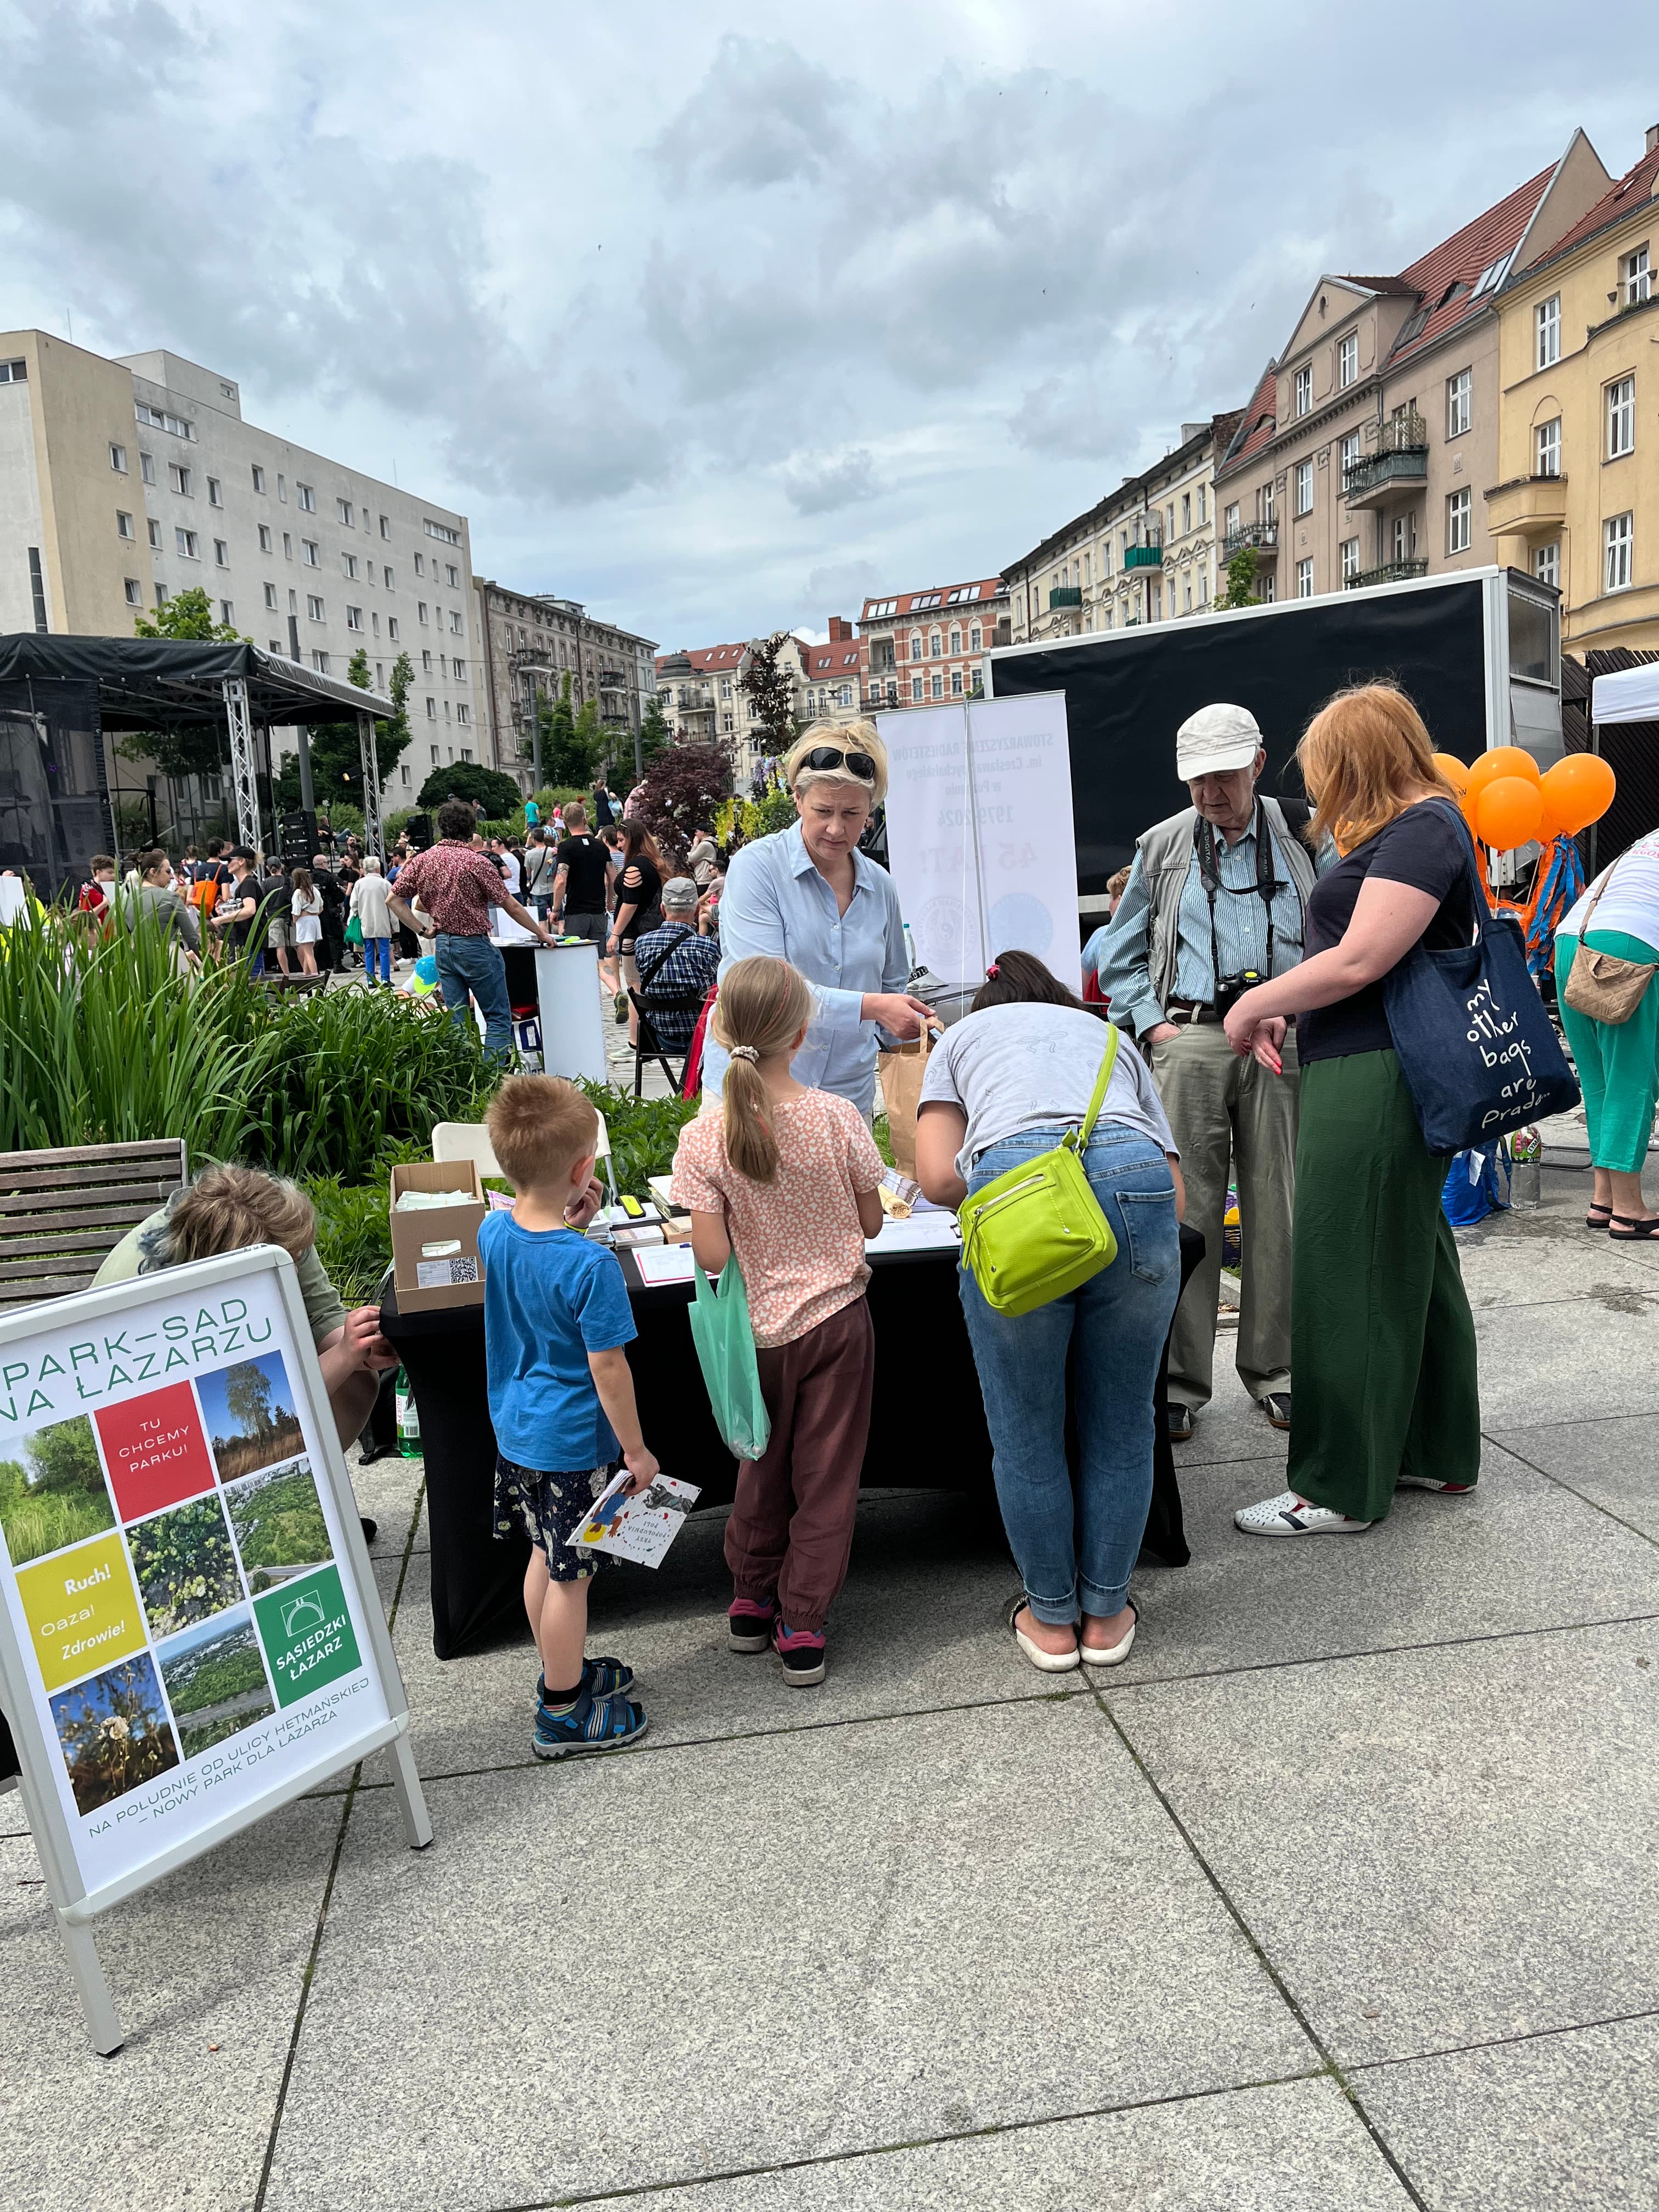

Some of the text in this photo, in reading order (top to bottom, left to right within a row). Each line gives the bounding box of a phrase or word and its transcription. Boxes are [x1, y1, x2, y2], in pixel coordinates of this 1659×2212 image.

[1467, 978, 1500, 1011] my
[1466, 1009, 1519, 1042] other
[1479, 1040, 1531, 1076] bags
[1501, 1077, 1537, 1098] are
[77, 1317, 272, 1399] ŁAZARZU
[139, 1418, 160, 1431] TU
[119, 1425, 189, 1458] CHCEMY
[129, 1443, 188, 1472] PARKU!
[64, 1564, 111, 1595] Ruch!
[41, 1604, 95, 1636] Oaza!
[61, 1620, 125, 1660] Zdrowie!
[276, 1615, 346, 1670] SĄSIEDZKI
[290, 1636, 343, 1680] ŁAZARZ
[89, 1678, 369, 1838] NA POŁUDNIE OD ULICY HETMAŃSKIEJ
[153, 1786, 198, 1818] NOWY
[204, 1762, 242, 1790] PARK
[247, 1745, 275, 1765] DLA
[279, 1710, 337, 1748] ŁAZARZA
